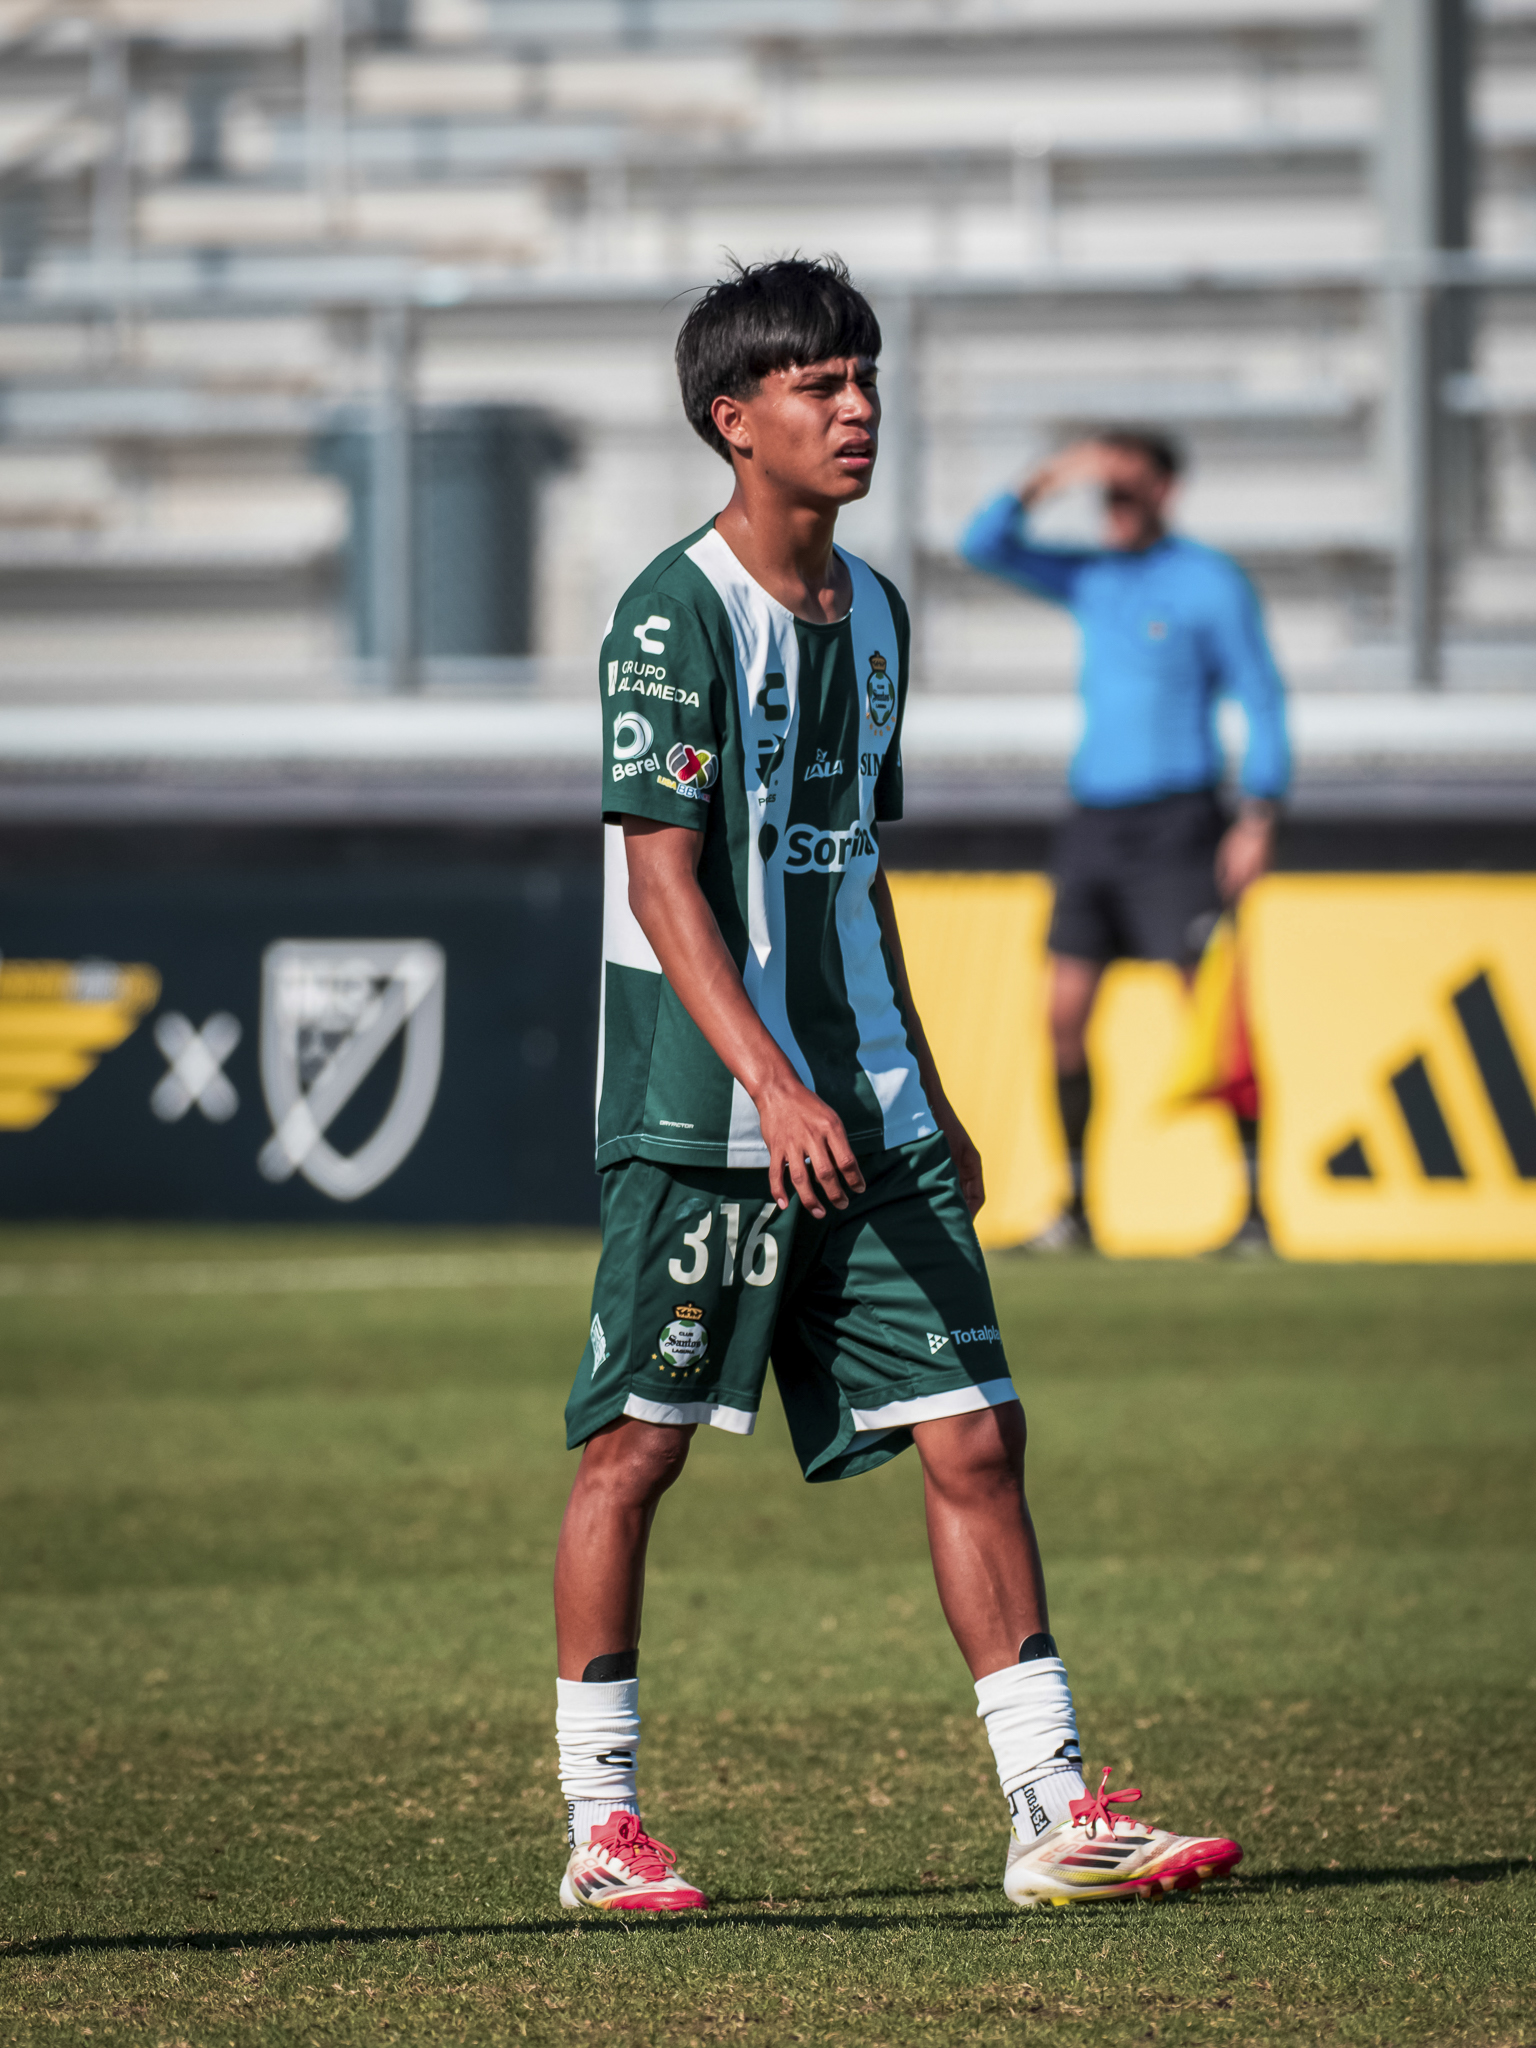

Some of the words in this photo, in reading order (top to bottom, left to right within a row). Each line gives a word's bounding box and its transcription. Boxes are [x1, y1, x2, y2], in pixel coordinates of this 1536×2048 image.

[621, 660, 667, 680] GRUPO
[617, 676, 700, 708] ALAMEDA
[612, 752, 660, 782] Berel
[668, 1202, 779, 1287] 316
[950, 1324, 1002, 1345] Totalpla
